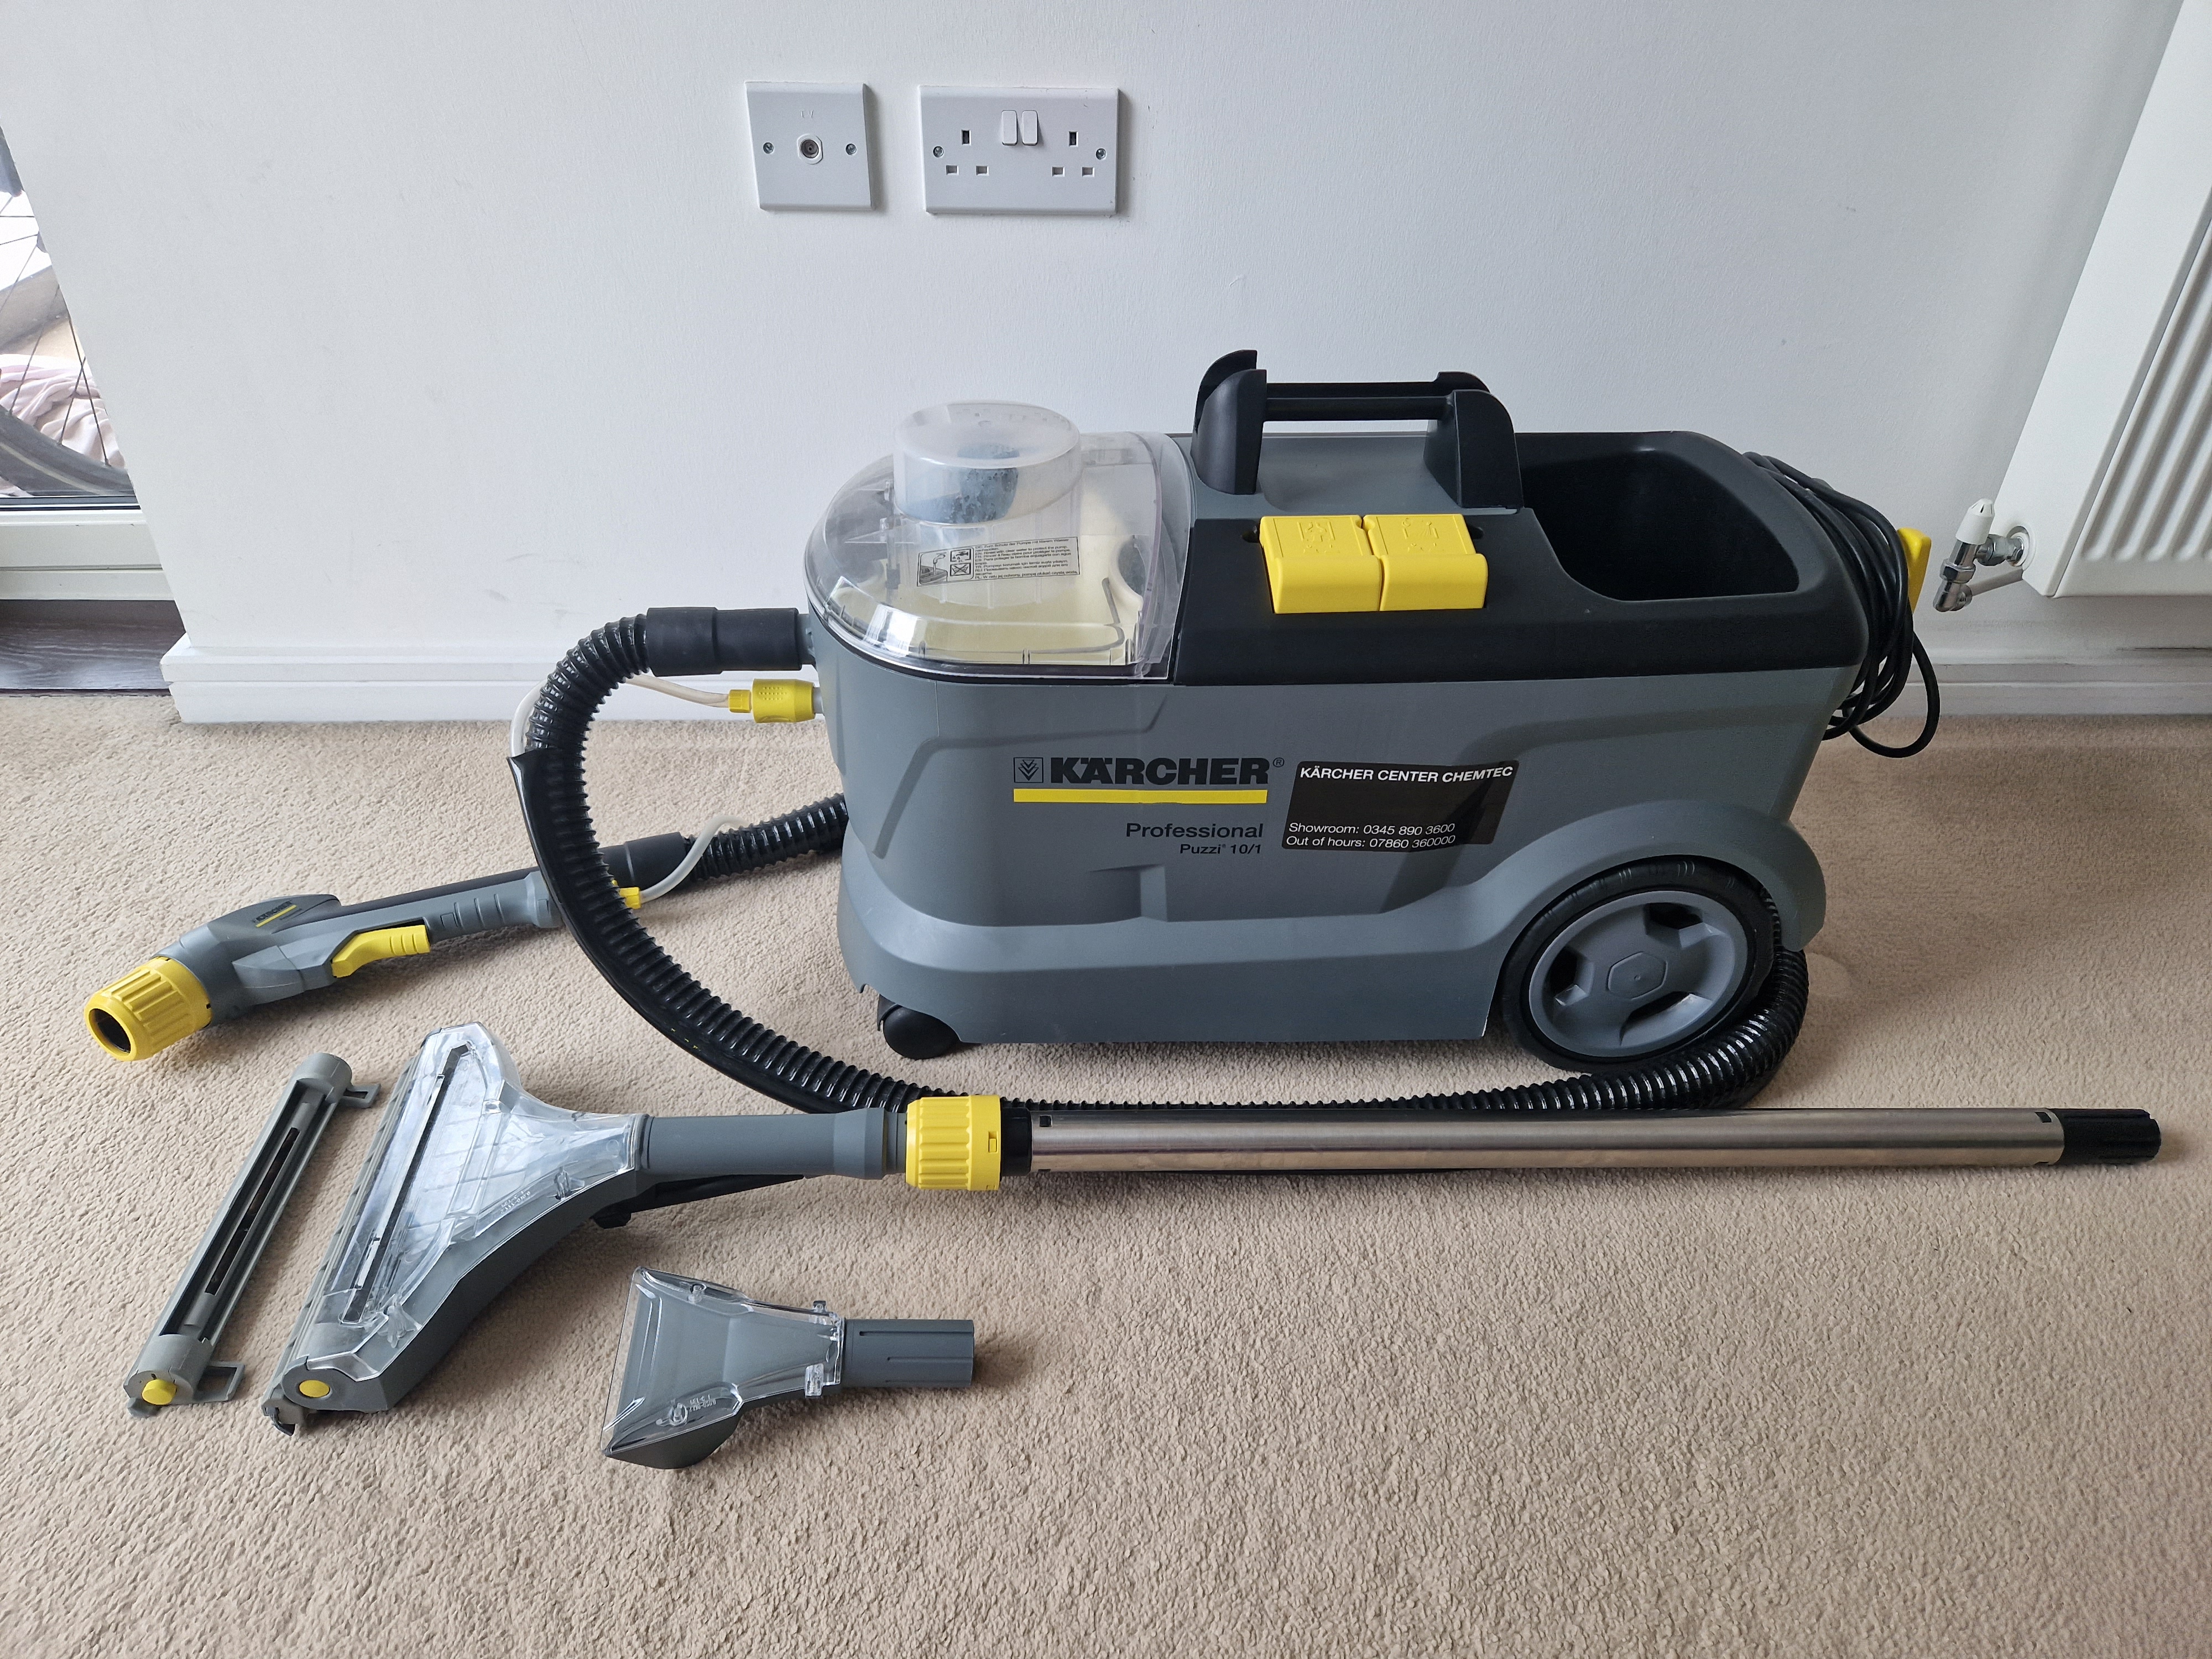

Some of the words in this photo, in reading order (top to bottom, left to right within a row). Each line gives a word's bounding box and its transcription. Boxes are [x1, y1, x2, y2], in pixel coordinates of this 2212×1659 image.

[1051, 757, 1270, 785] KÄRCHER
[1300, 765, 1374, 780] KÄRCHER
[1378, 770, 1438, 782] CENTER
[1442, 766, 1513, 782] CHEMTEC
[1126, 822, 1264, 838] Professional
[1288, 822, 1359, 834] Showroom:
[1363, 825, 1395, 834] 0345
[1399, 826, 1423, 836] 890
[1425, 823, 1455, 835] 3600
[1230, 844, 1261, 854] 10/1
[1286, 836, 1309, 846] Out
[1312, 837, 1326, 846] of
[1327, 837, 1366, 847] hours:
[1369, 838, 1409, 848] 07860
[1412, 835, 1455, 848] 360000
